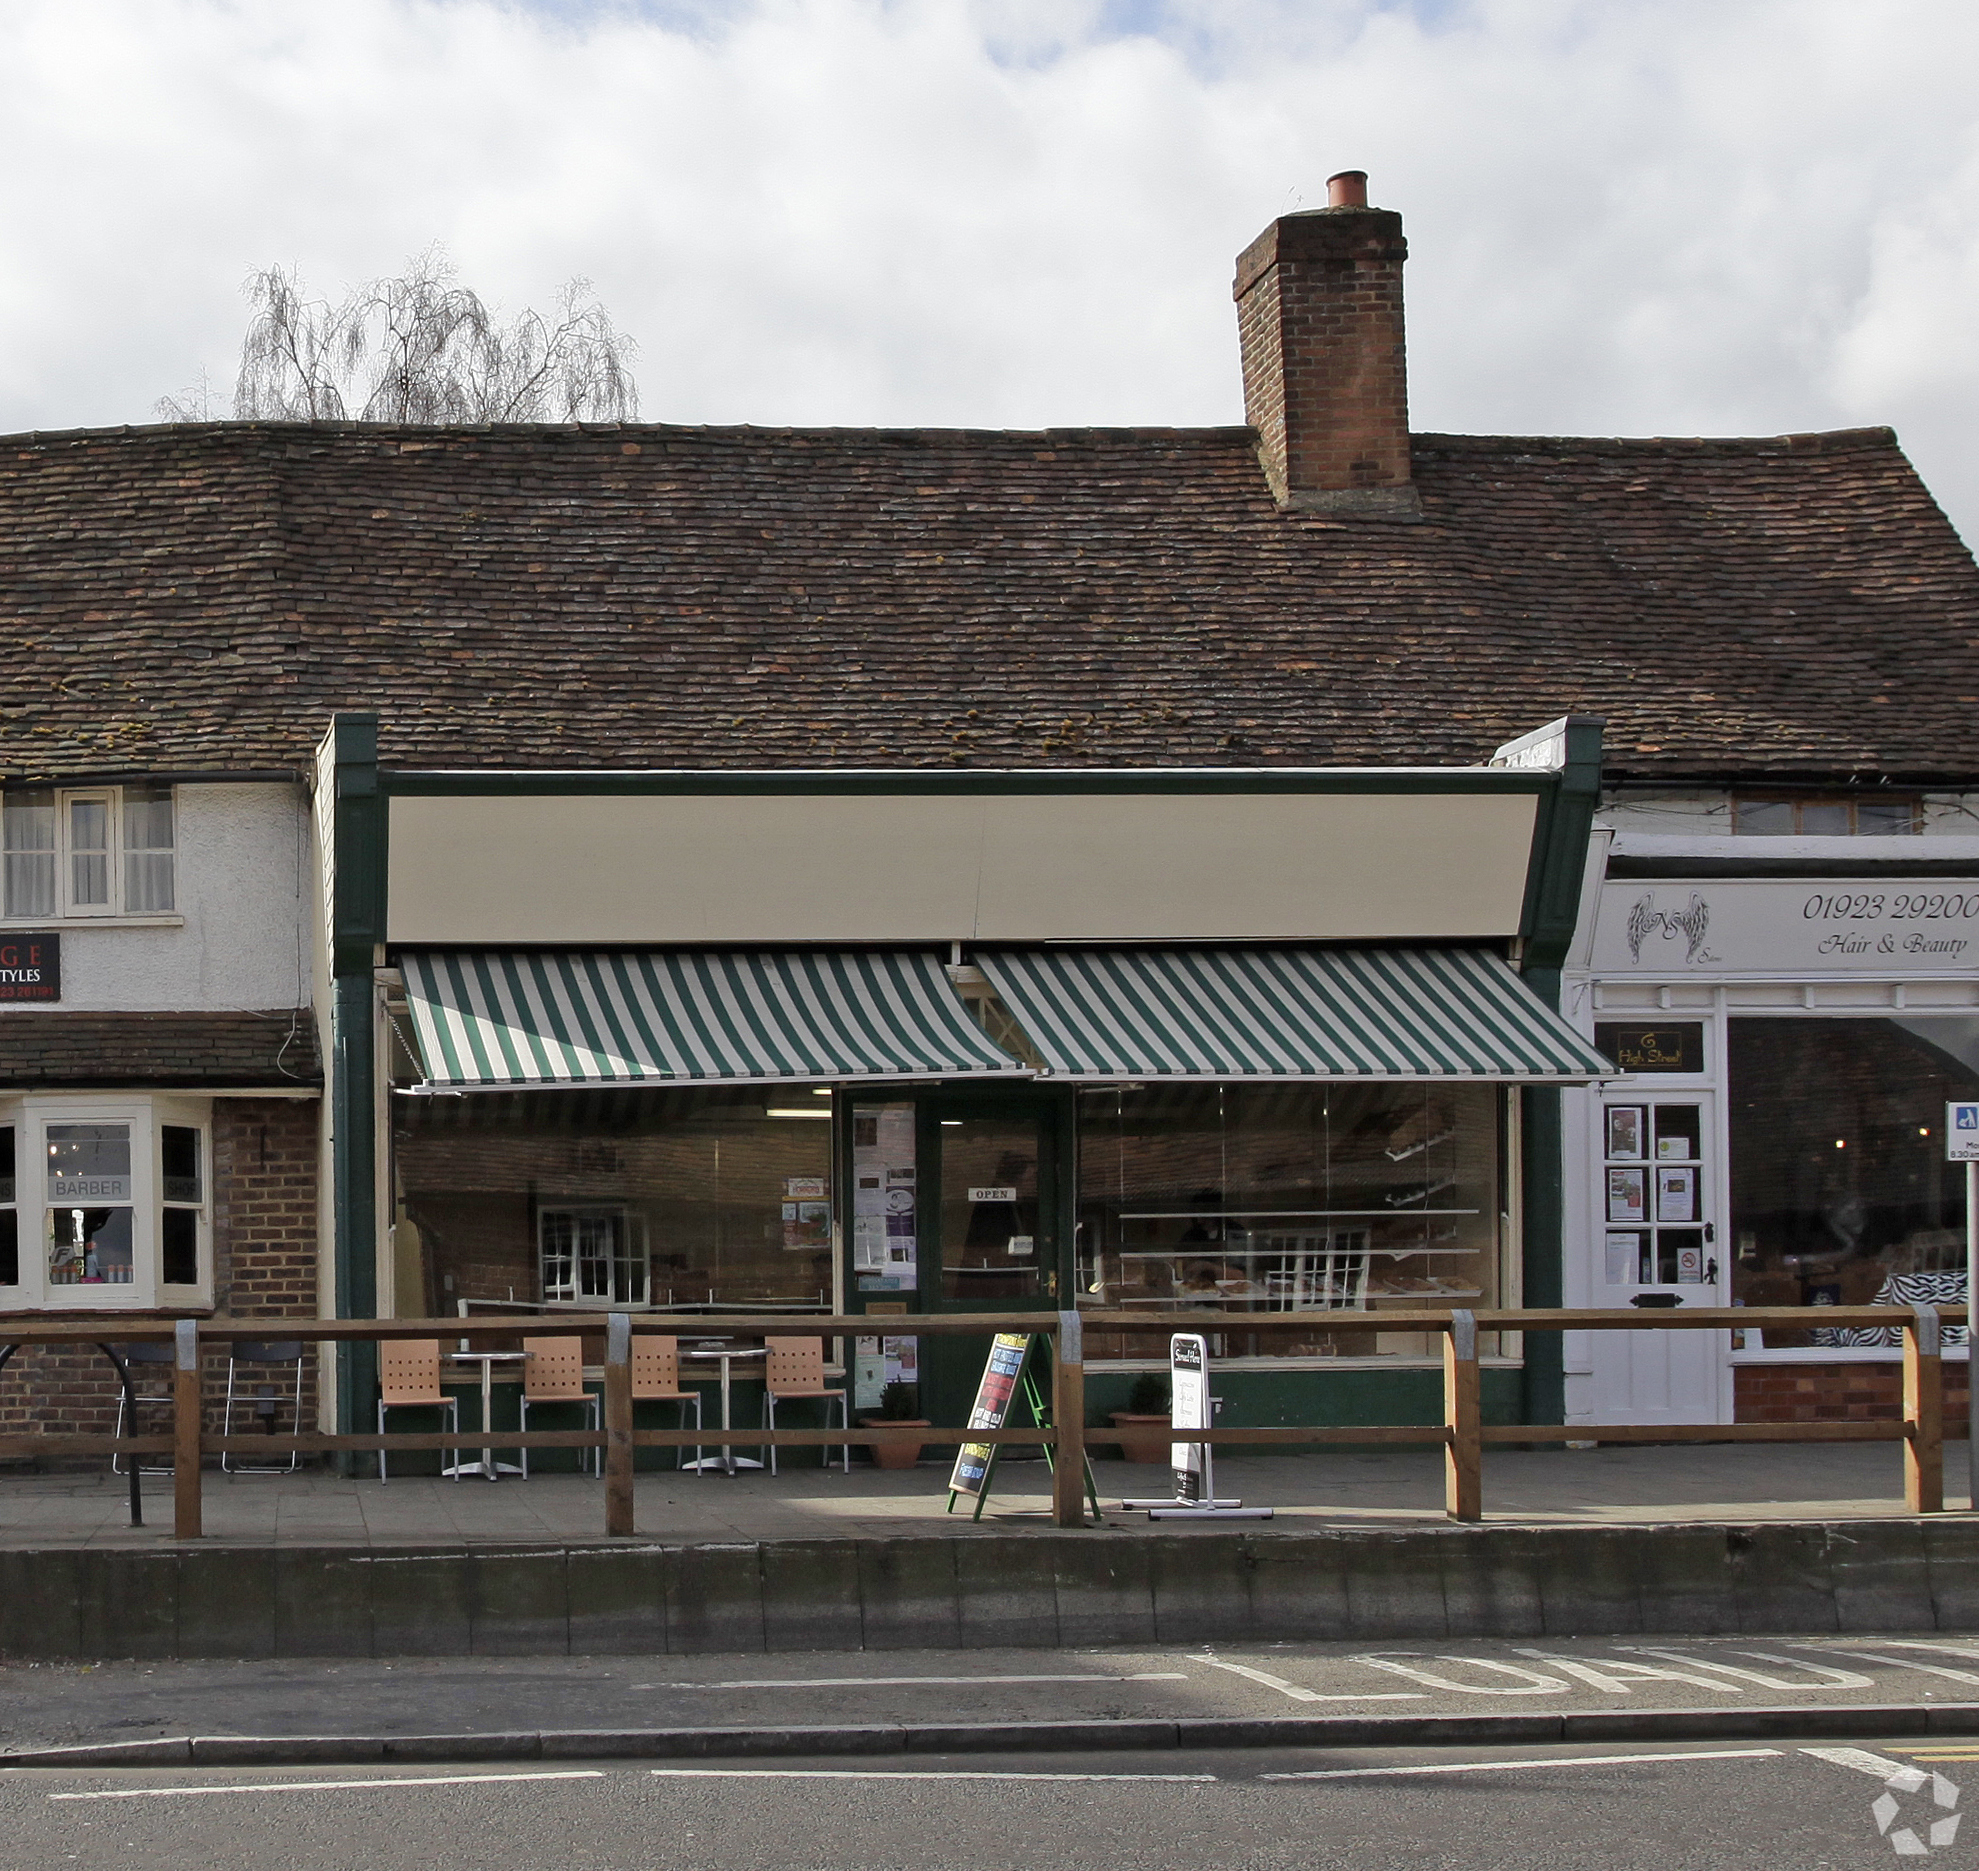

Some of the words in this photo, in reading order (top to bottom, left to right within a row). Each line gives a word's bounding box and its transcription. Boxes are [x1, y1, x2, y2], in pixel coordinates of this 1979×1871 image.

[1803, 894, 1885, 920] 01923
[1818, 932, 1872, 955] Hair
[1877, 933, 1896, 954] &
[1903, 933, 1968, 960] Beauty
[56, 1180, 122, 1196] BARBER
[976, 1190, 1008, 1199] OPEN
